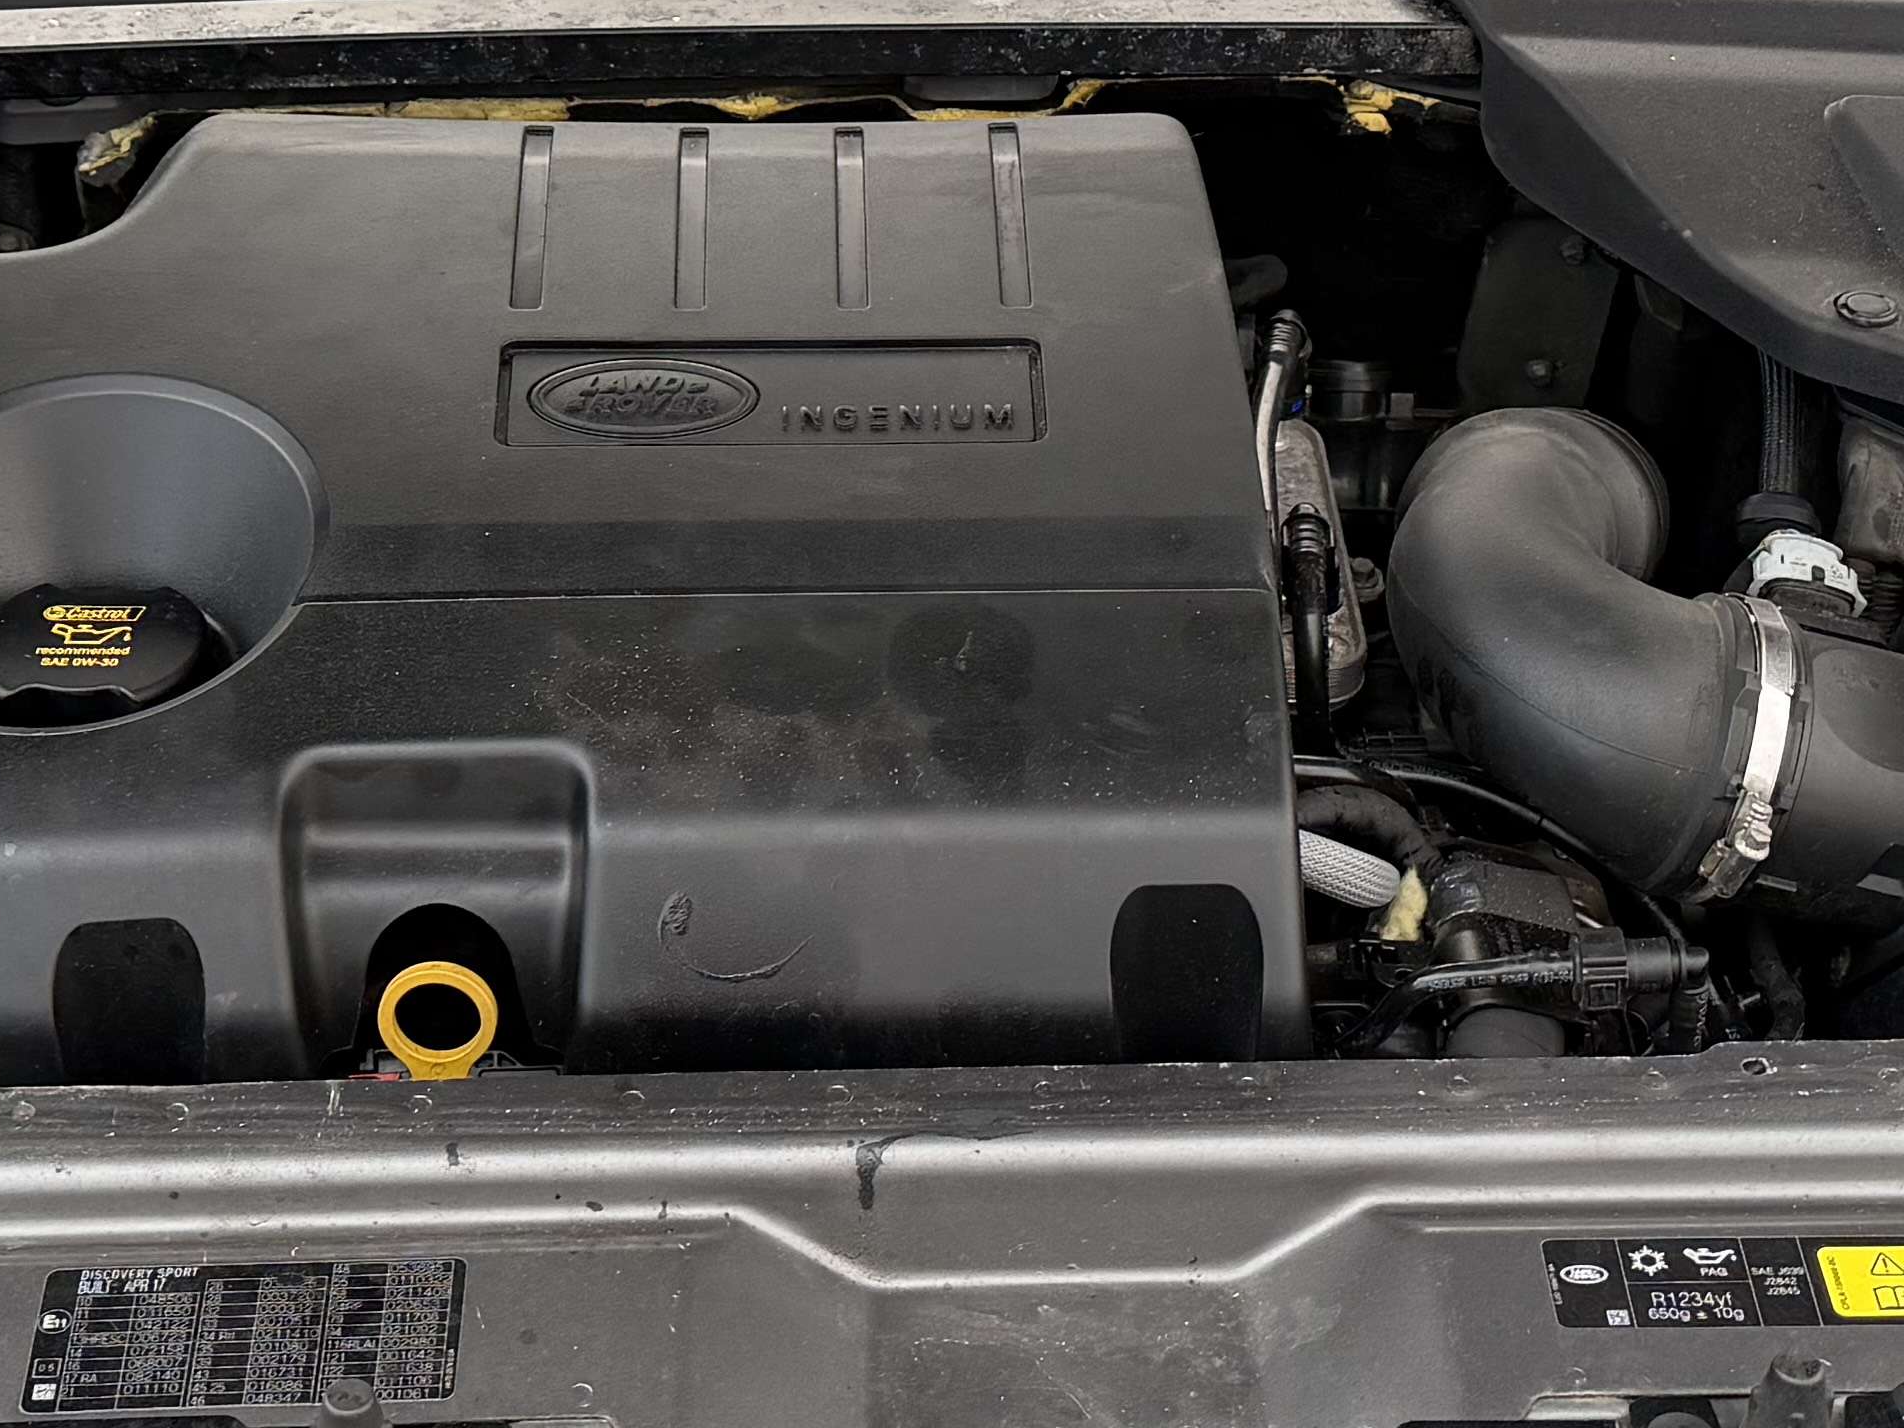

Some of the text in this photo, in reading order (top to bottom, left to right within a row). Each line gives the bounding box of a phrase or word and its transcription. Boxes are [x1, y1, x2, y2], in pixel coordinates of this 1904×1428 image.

[780, 403, 1015, 431] INGENIUM
[66, 607, 131, 620] Castrol
[35, 646, 131, 655] recommended
[40, 657, 119, 666] SAE 0W-30
[80, 1266, 199, 1280] DISCOVERY SPORT
[1700, 1267, 1728, 1277] PAG
[122, 1278, 150, 1292] APR
[1651, 1291, 1734, 1310] R1234yf
[1649, 1307, 1690, 1321] 650g
[1714, 1307, 1744, 1321] 10g
